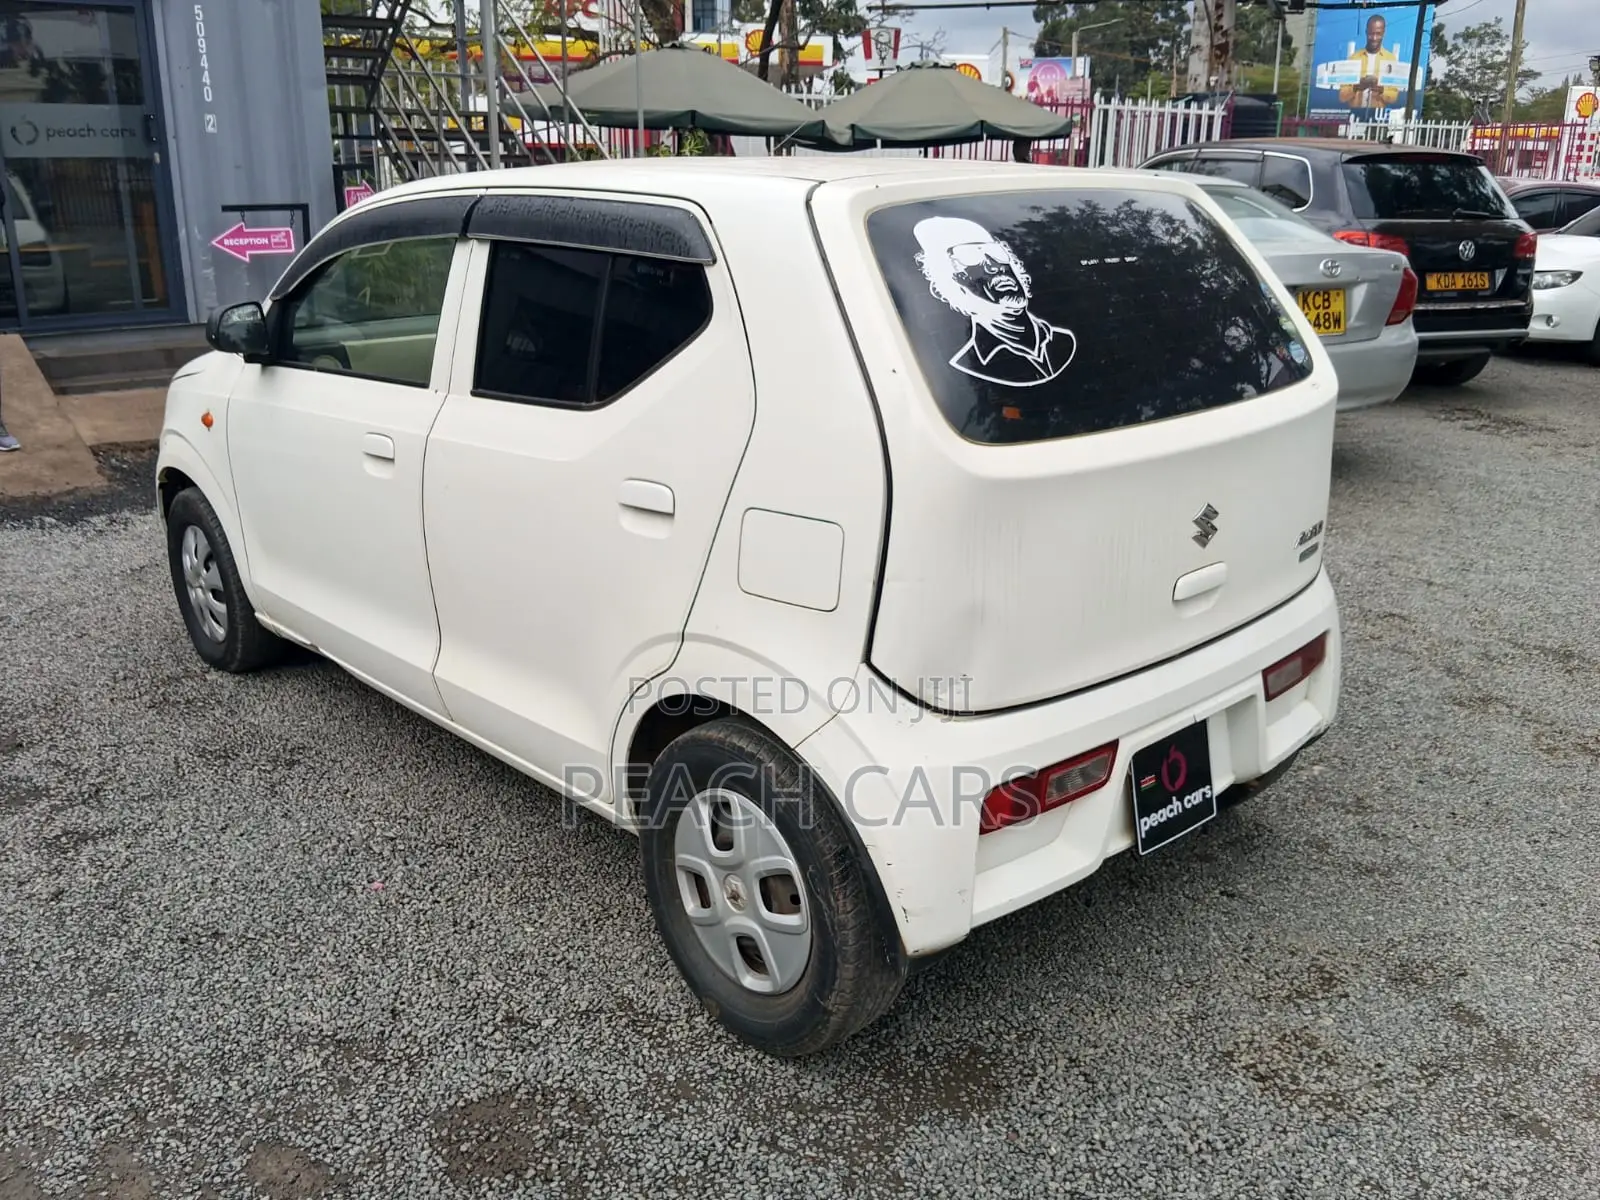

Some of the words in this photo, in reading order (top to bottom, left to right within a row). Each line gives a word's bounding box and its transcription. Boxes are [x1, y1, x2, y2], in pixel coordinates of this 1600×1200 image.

[194, 4, 213, 102] 509440
[46, 122, 97, 142] peach
[100, 127, 137, 138] cars
[223, 237, 270, 246] RECEPTION
[1436, 273, 1457, 289] KDA
[1460, 273, 1486, 288] 161S
[1302, 291, 1332, 311] KCB
[1304, 311, 1342, 330] 48W
[1140, 796, 1183, 839] peach
[1184, 784, 1212, 809] cars
